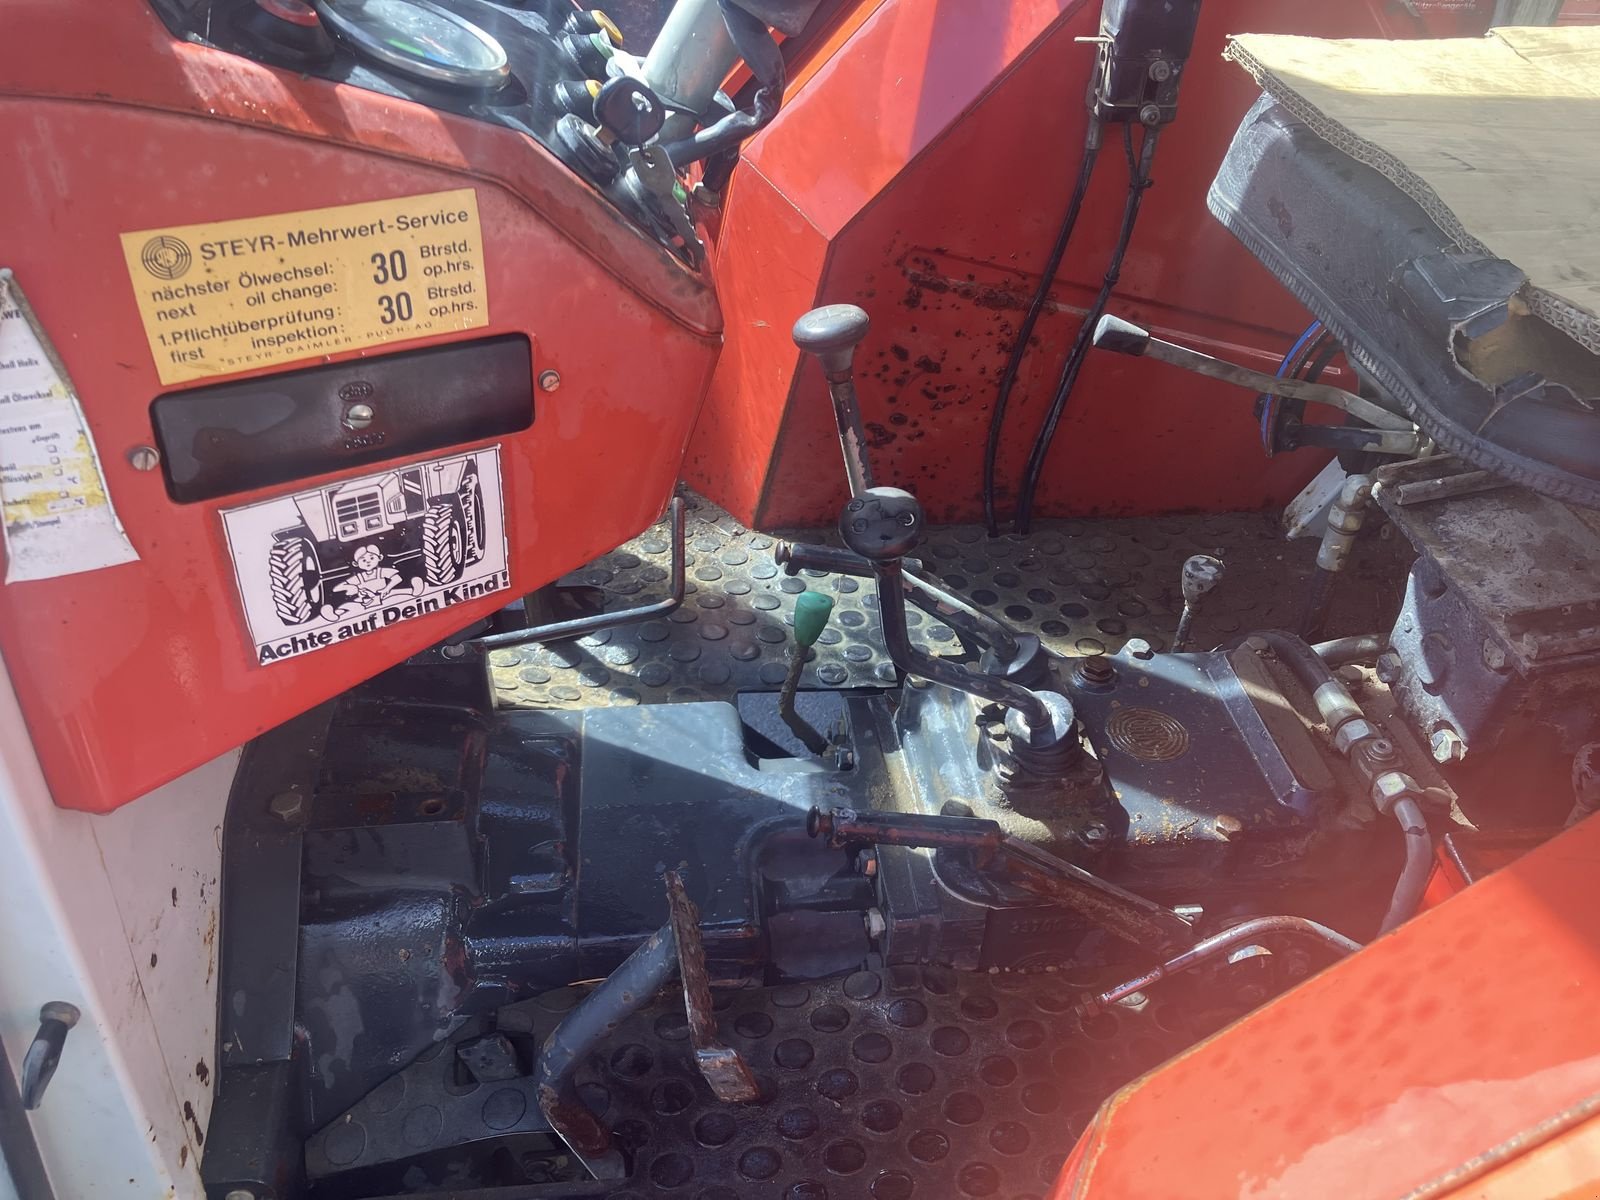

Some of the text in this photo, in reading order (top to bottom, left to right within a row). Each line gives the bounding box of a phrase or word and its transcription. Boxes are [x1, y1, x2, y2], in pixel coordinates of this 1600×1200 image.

[419, 239, 472, 259] Btrstd.
[370, 249, 408, 286] 30
[423, 259, 474, 278] op.hrs.
[151, 261, 334, 302] nächster Ölwechsel:
[427, 281, 476, 300] Btrstd.
[156, 281, 338, 322] next oil change:
[377, 291, 413, 325] 30
[429, 299, 478, 318] op.hrs.
[169, 347, 205, 364] first
[259, 628, 333, 664] Achte
[338, 613, 379, 639] auf
[382, 597, 439, 626] Dein
